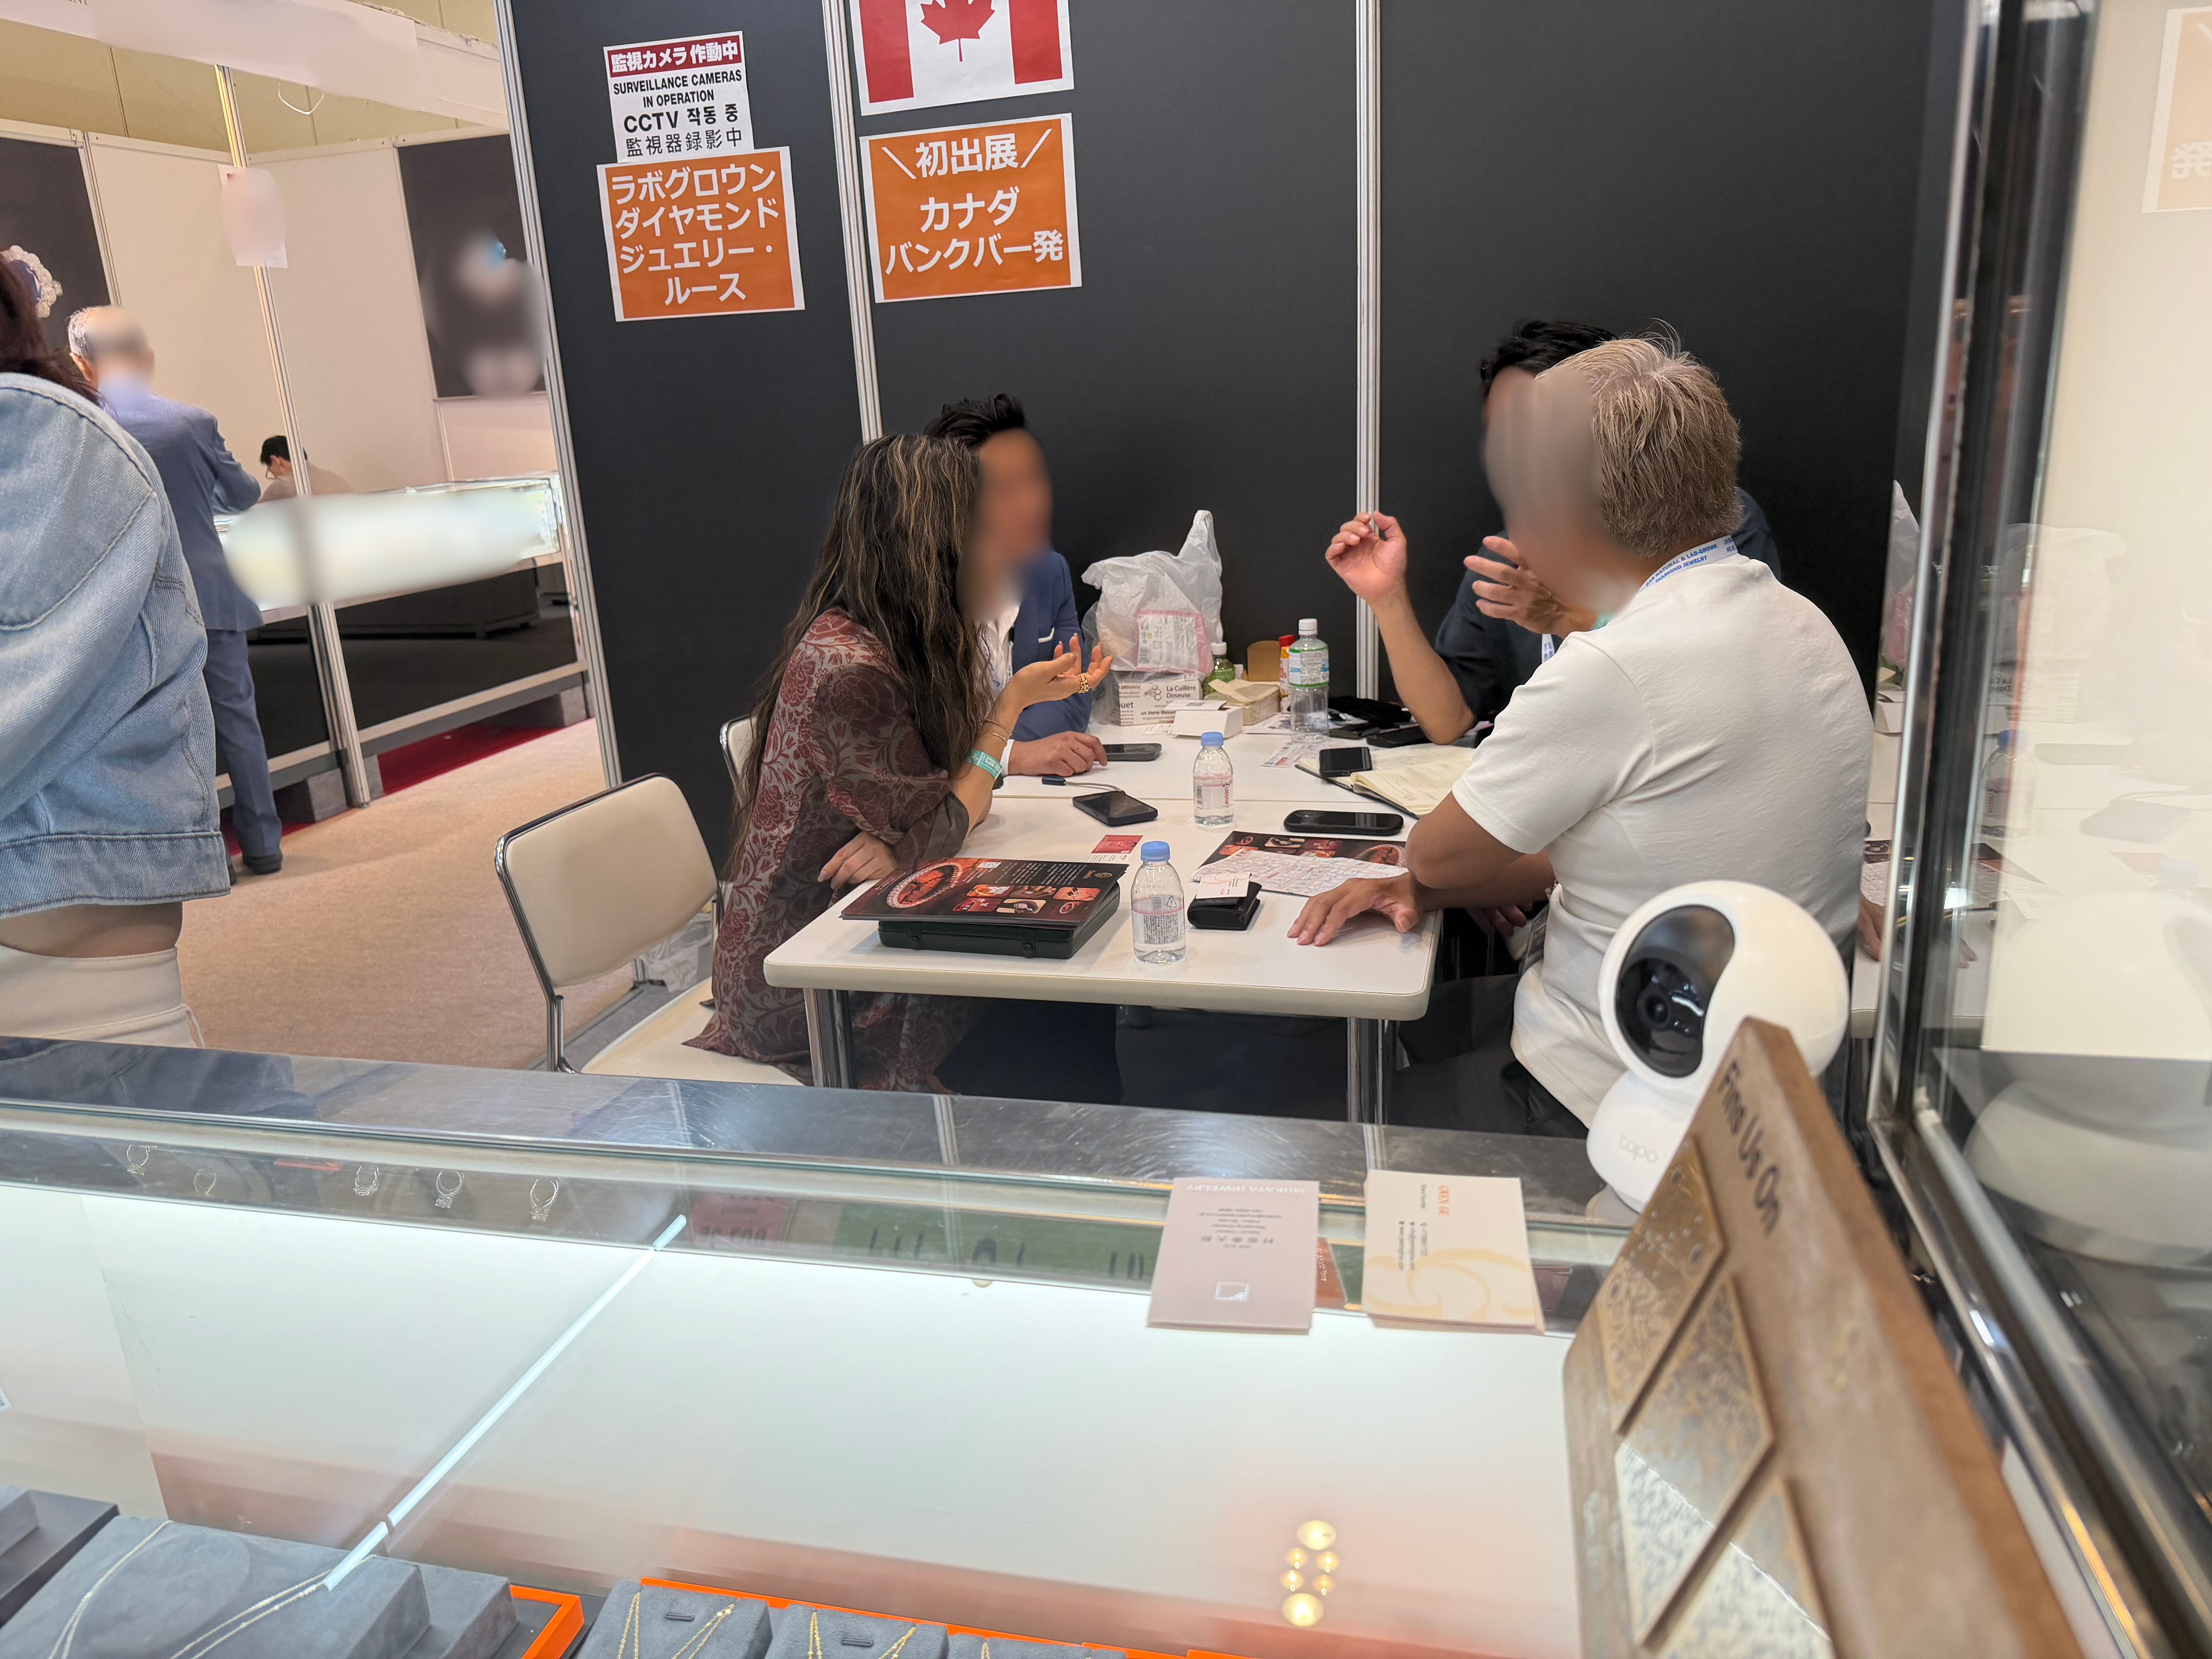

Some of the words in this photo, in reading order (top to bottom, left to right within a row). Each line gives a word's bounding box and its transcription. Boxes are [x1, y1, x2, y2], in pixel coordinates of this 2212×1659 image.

[611, 40, 738, 73] 監視カメラ作動中
[613, 75, 689, 95] SURVEILLANCE
[691, 69, 742, 86] CAMERAS
[643, 96, 653, 108] IN
[656, 89, 714, 106] OPERATION
[624, 111, 678, 133] CCTV
[687, 105, 716, 126] 작동
[725, 103, 738, 123] 중
[611, 163, 776, 205] ラボグロウン
[615, 197, 779, 240] ダイヤモンド
[920, 185, 1020, 233] カナダ
[885, 229, 1064, 275] バンクバー発
[665, 273, 747, 306] ルース
[1655, 559, 1680, 577] NATURAL
[1686, 543, 1717, 559] LAB-GROWN
[1655, 565, 1682, 583] DIAMOND
[1683, 555, 1707, 568] JEWELRY
